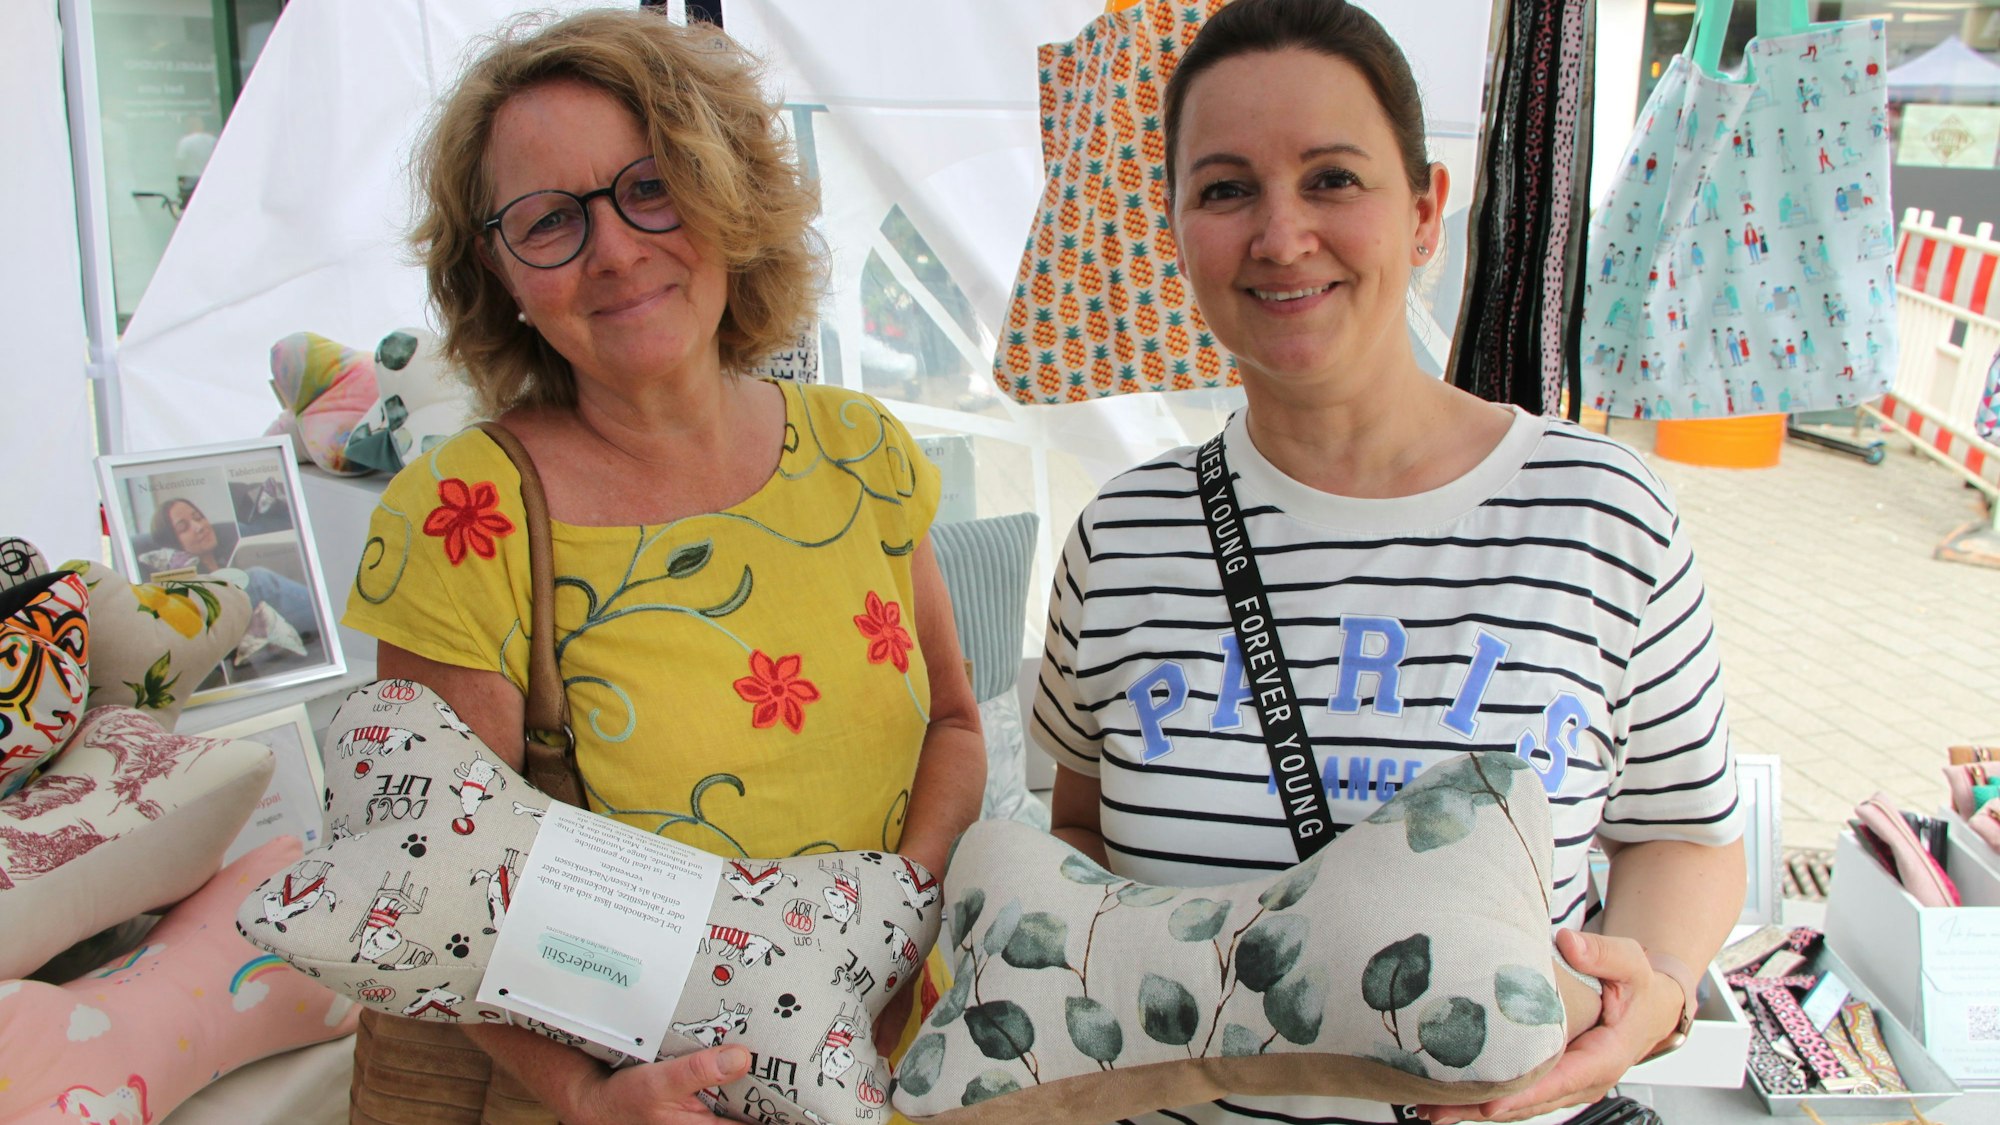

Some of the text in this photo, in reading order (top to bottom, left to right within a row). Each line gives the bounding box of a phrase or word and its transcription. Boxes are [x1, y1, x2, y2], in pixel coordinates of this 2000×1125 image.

[138, 477, 206, 494] Nackenstütze
[1207, 486, 1248, 575] YOUNG
[381, 684, 414, 700] GOOD
[1125, 613, 1592, 797] PARIS
[1235, 595, 1324, 839] FOREVER YOUNG
[372, 774, 431, 796] LIFE
[255, 793, 282, 811] aypal
[366, 796, 427, 825] DOGS
[557, 815, 585, 829] Kissen
[586, 825, 600, 834] das
[621, 838, 640, 848] Man
[573, 837, 677, 880] Er ist ideal für gemütliche
[625, 847, 648, 860] lange
[597, 860, 643, 882] verwenden.
[687, 860, 703, 870] und
[540, 862, 685, 921] oder Tabletstütze, Rückenstütze oder
[552, 855, 681, 908] einfach als Kissen/Nackenkissen
[535, 873, 682, 934] Der Leseknochen lässt sich als Buch-
[791, 899, 811, 917] BOY
[785, 911, 811, 931] GOOD
[793, 936, 811, 945] am
[541, 944, 630, 987] WunderStil
[858, 1082, 884, 1103] GOOD
[855, 1107, 872, 1118] am
